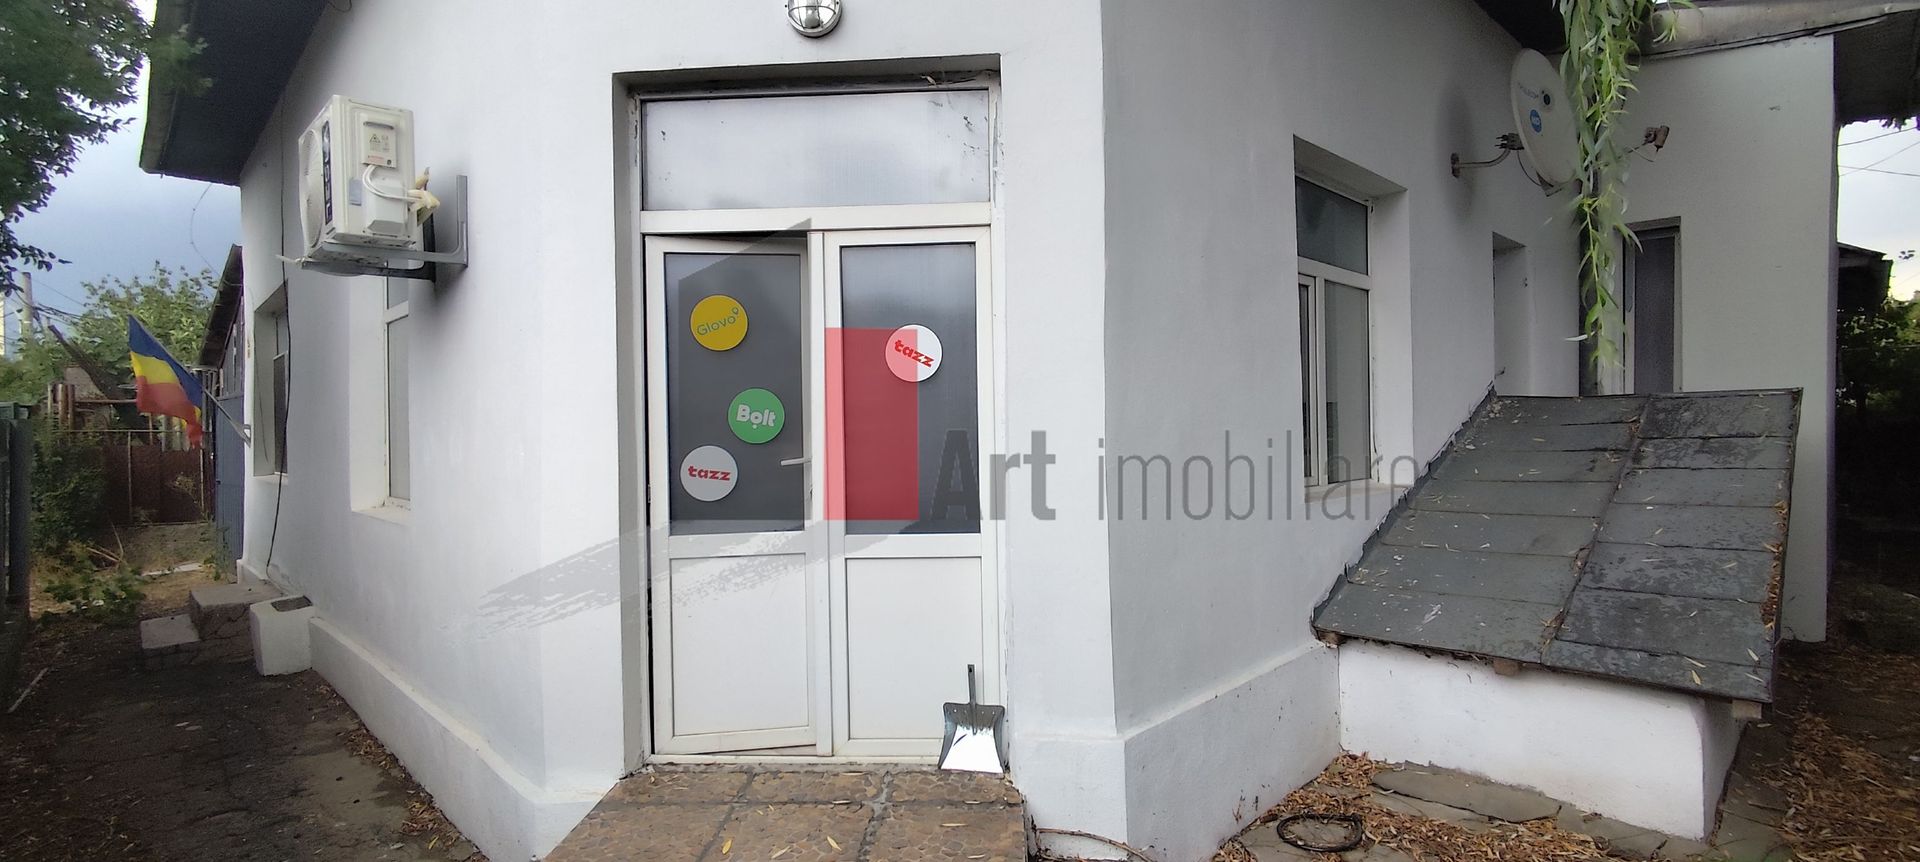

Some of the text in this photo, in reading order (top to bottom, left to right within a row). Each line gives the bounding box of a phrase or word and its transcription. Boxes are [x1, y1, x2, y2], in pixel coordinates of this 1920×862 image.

[696, 313, 737, 337] Glovo
[894, 339, 935, 368] tazz
[736, 404, 777, 428] Bolt
[687, 465, 731, 482] tazz
